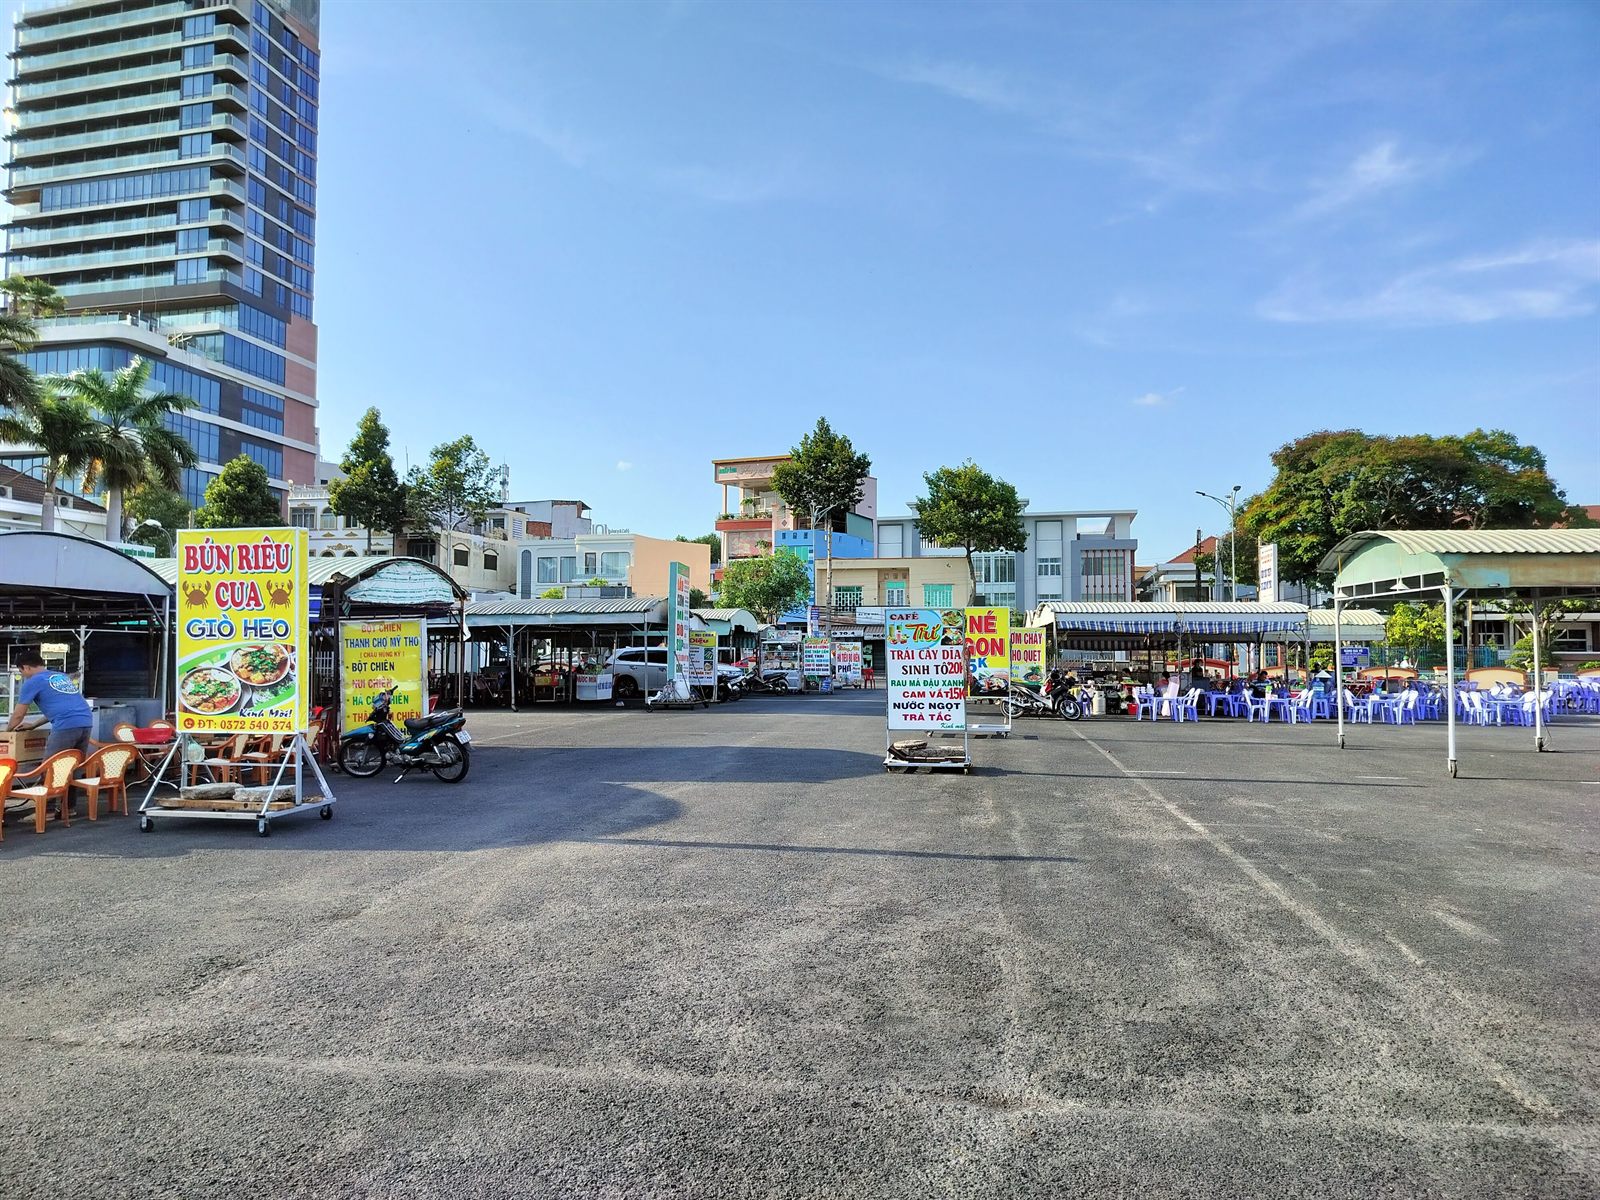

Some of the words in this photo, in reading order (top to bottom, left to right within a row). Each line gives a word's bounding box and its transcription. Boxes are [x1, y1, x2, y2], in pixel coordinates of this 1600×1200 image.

[185, 537, 233, 573] BÚN
[237, 536, 292, 573] RIÊU
[215, 581, 264, 610] CUA
[890, 612, 919, 621] CAFÉ
[186, 614, 236, 640] GIÒ
[243, 618, 290, 640] HEO
[1010, 632, 1022, 645] ƠM
[890, 647, 915, 660] TRÁI
[965, 638, 1006, 657] GON
[1011, 650, 1022, 662] HO
[352, 660, 368, 674] BỘT
[370, 659, 395, 672] CHIÊN
[902, 664, 930, 675] SINH
[368, 676, 393, 689] CHIÊN
[890, 679, 907, 687] RAU
[909, 678, 921, 687] MÁ
[941, 679, 965, 687] XANH
[389, 692, 409, 705] HIÊN
[893, 701, 925, 710] NƯỚC
[928, 702, 961, 711] NGỌT
[396, 708, 421, 722] CHIÊN
[902, 711, 925, 721] TRÀ
[197, 720, 217, 730] ĐT:
[220, 720, 246, 730] 0372
[250, 720, 269, 730] 540
[272, 720, 292, 730] 374
